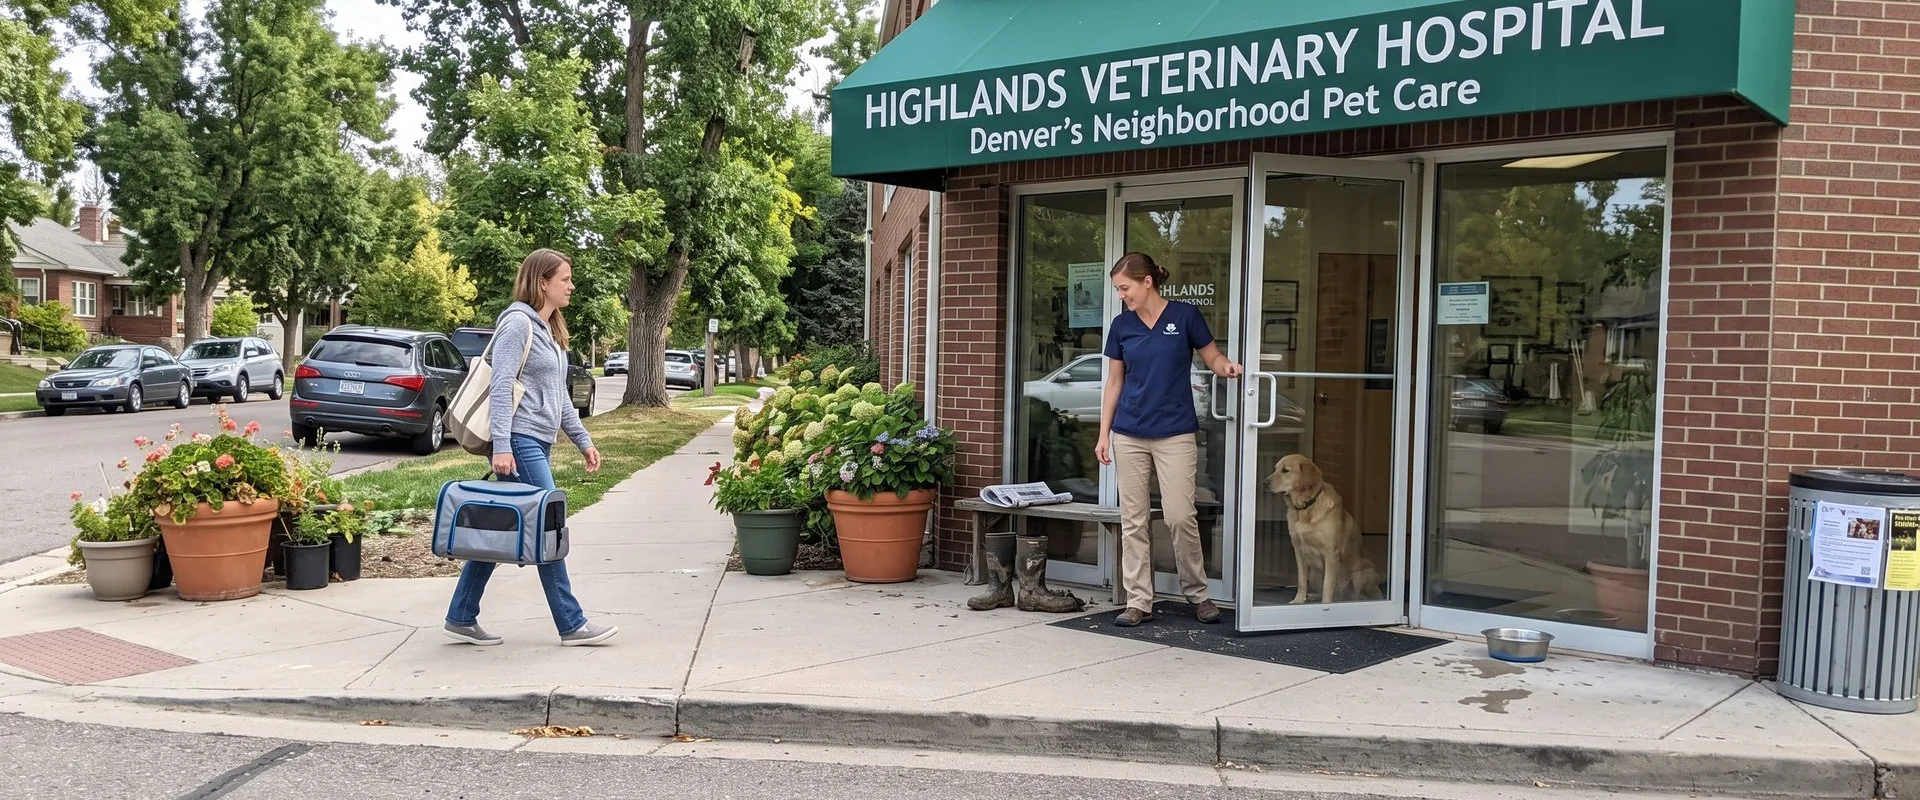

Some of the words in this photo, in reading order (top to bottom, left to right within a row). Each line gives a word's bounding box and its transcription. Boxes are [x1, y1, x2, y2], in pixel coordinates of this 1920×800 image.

[865, 68, 1068, 130] HIGHLANDS
[1080, 27, 1360, 105] VETERINARY
[1376, 0, 1666, 70] HOSPITAL
[1093, 91, 1311, 146] Neighborhood
[1322, 85, 1380, 120] Pet
[1393, 79, 1481, 112] Care
